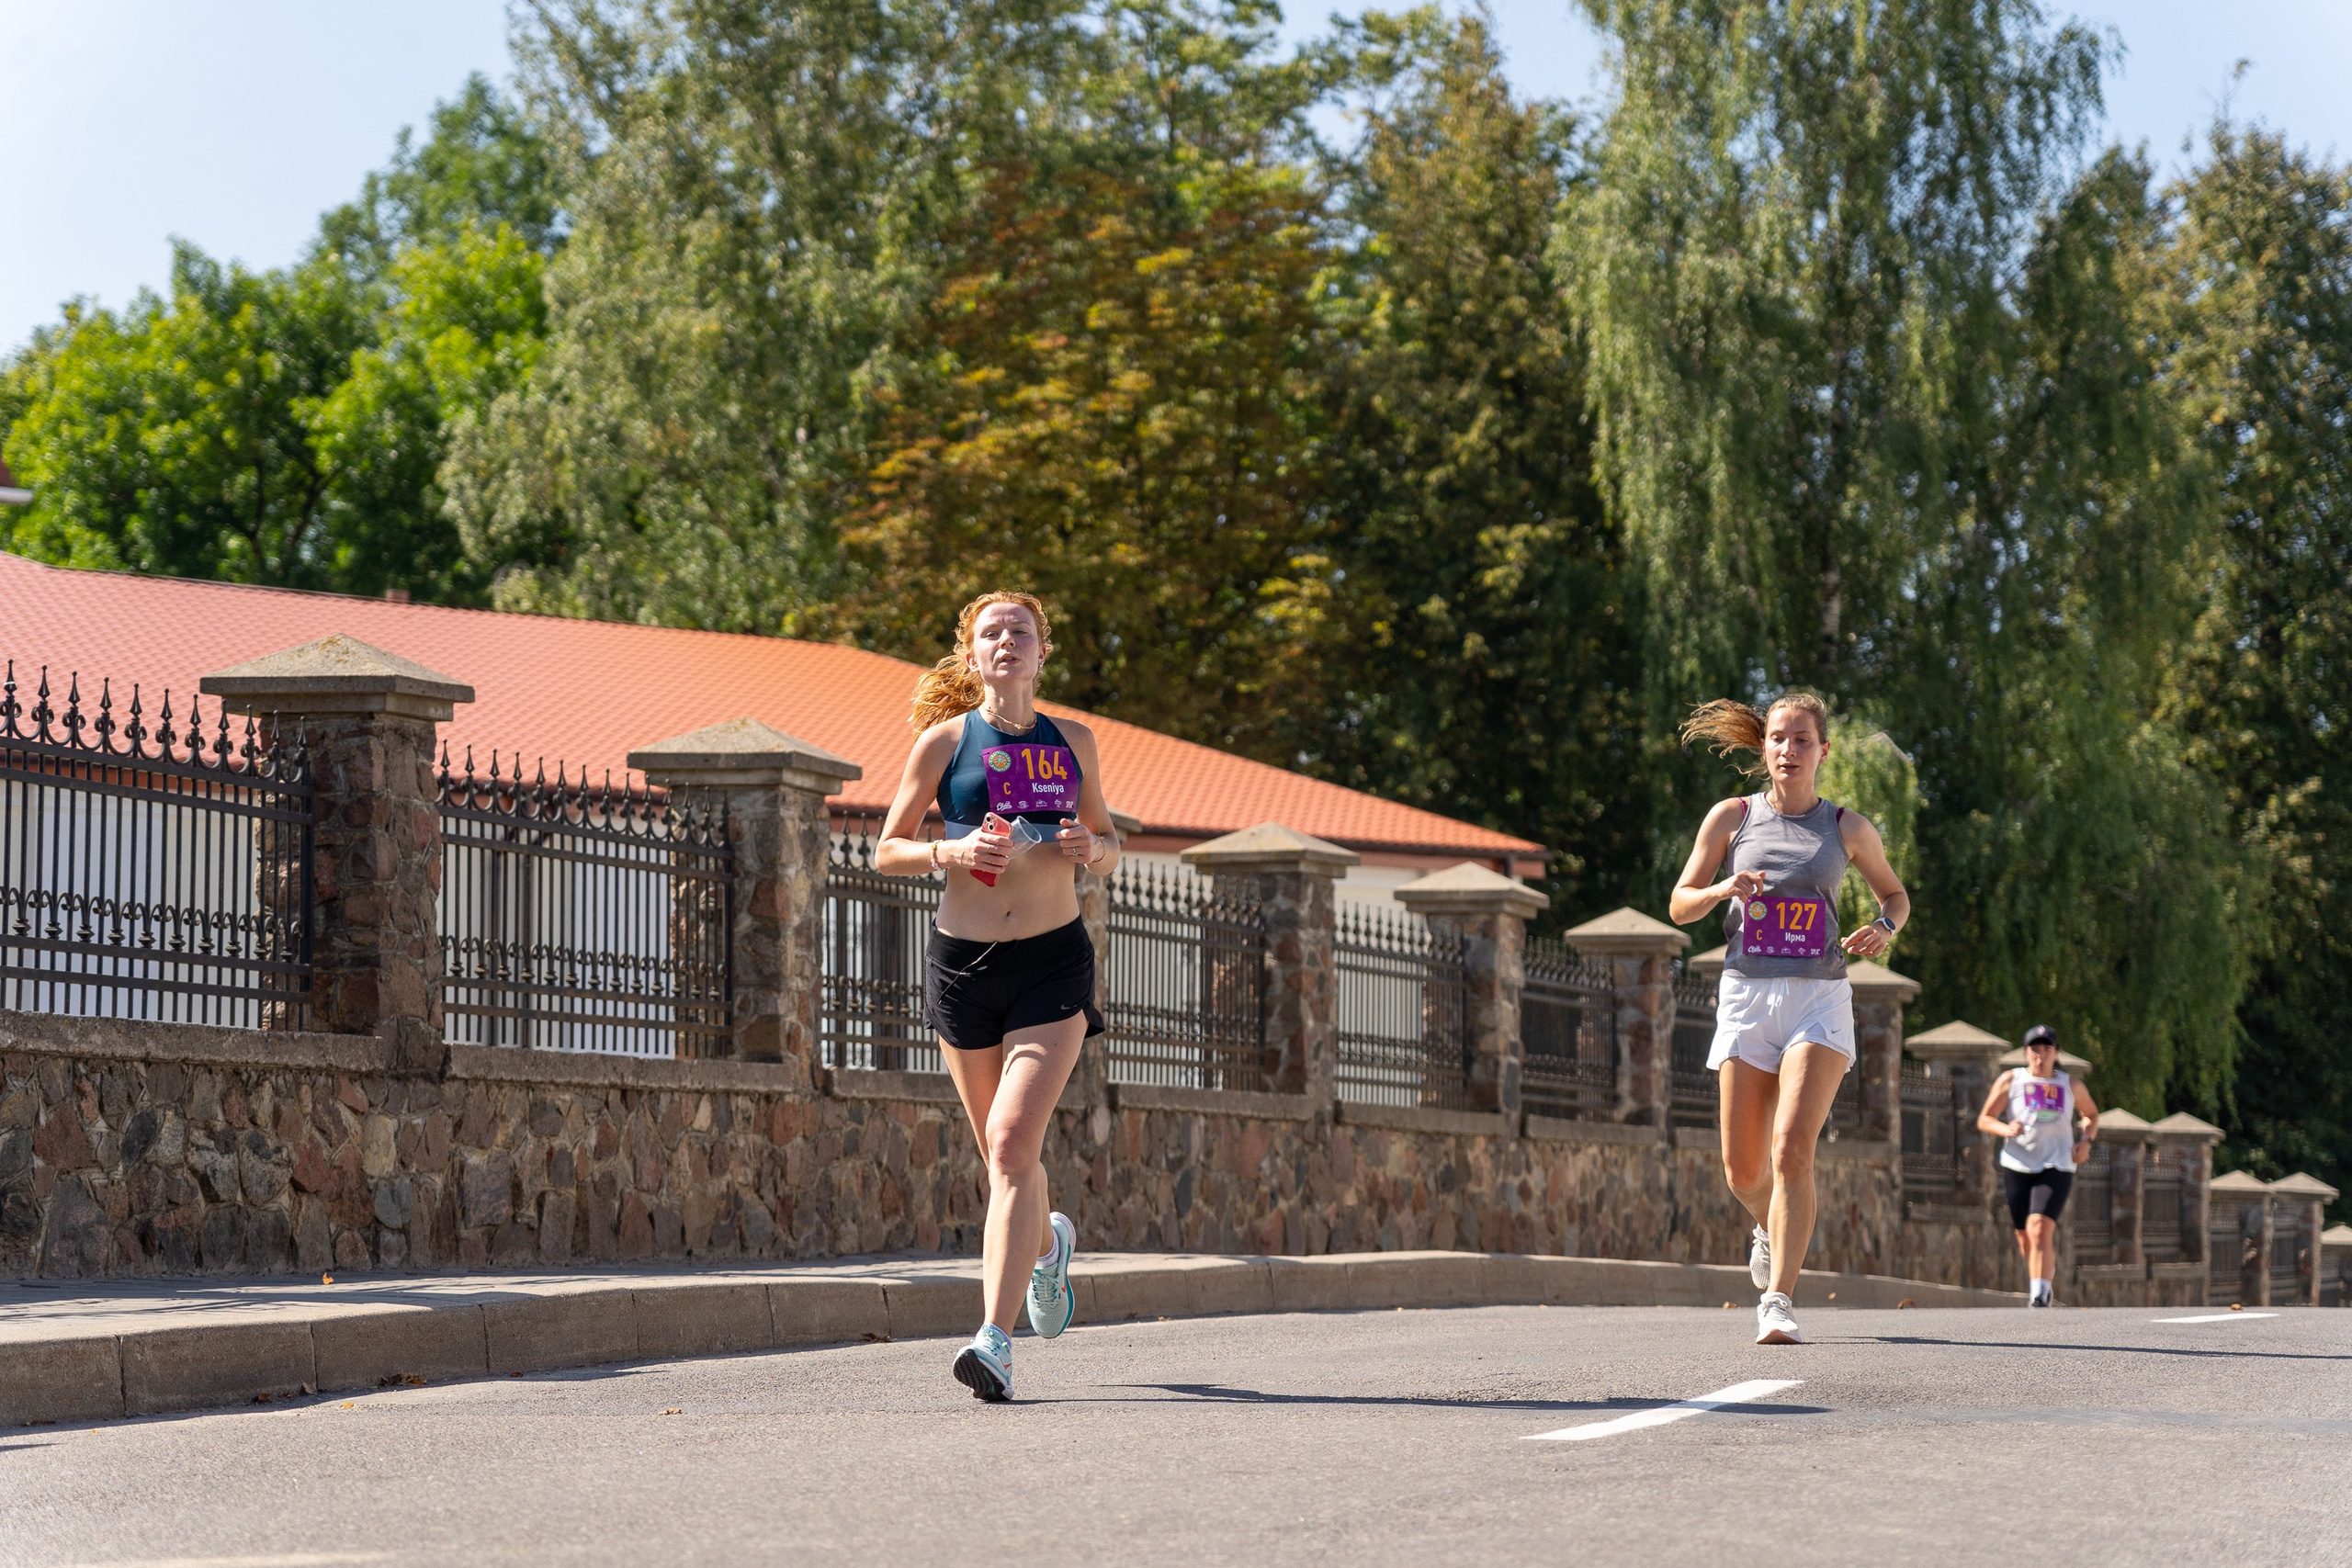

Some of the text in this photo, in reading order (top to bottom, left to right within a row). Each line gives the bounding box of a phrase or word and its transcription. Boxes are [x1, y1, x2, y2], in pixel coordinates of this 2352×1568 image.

[1021, 748, 1068, 780] 164
[1032, 783, 1064, 795] Kseniya
[1776, 902, 1817, 931] 127
[1785, 931, 1805, 943] Ирма
